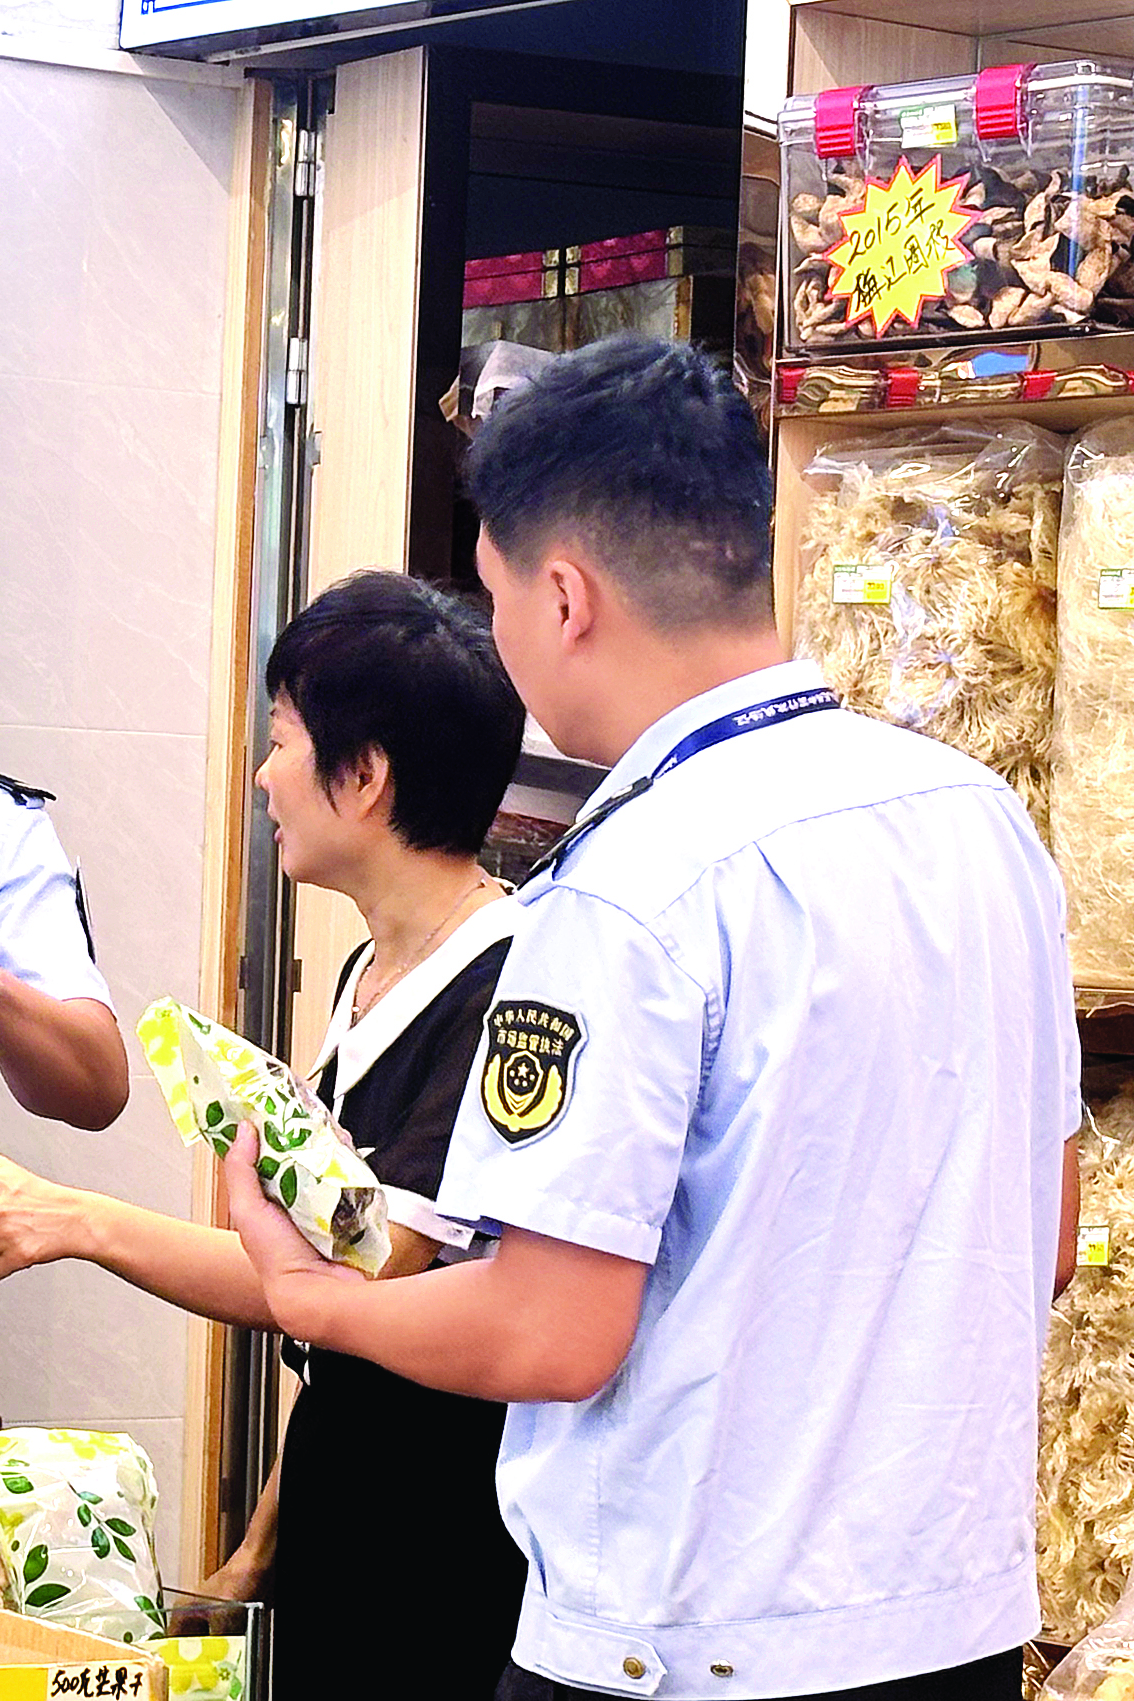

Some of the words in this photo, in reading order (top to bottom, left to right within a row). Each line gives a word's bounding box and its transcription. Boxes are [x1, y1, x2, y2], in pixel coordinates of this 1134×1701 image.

[848, 187, 936, 266] 2015年
[493, 1007, 575, 1042] 中华人民共和国
